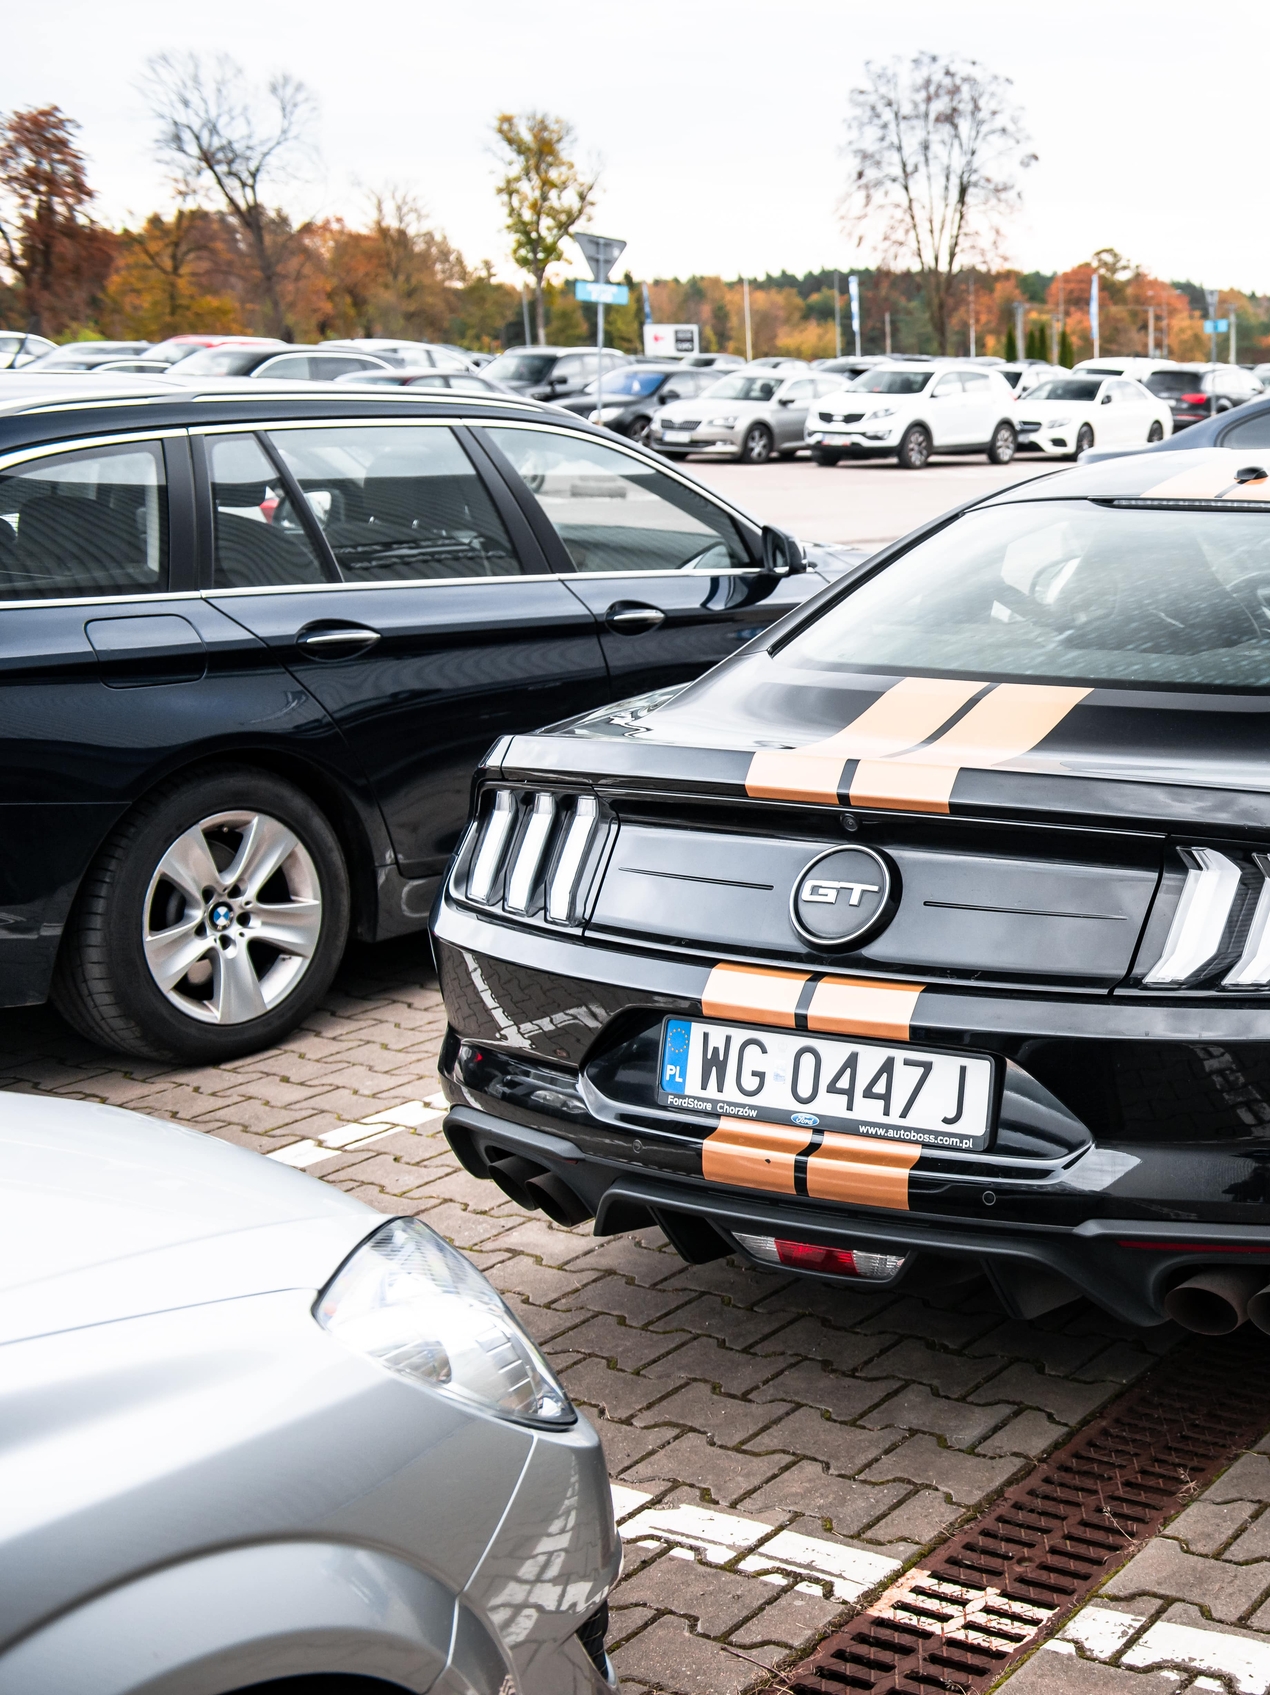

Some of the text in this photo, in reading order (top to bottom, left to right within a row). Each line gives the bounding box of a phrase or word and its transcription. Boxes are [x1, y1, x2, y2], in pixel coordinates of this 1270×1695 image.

[801, 880, 880, 907] GT
[665, 1064, 683, 1083] PL
[700, 1031, 967, 1125] WG 0447J
[667, 1095, 758, 1118] FordStore Chorzów
[859, 1124, 974, 1149] www.autoboss.com.pl
